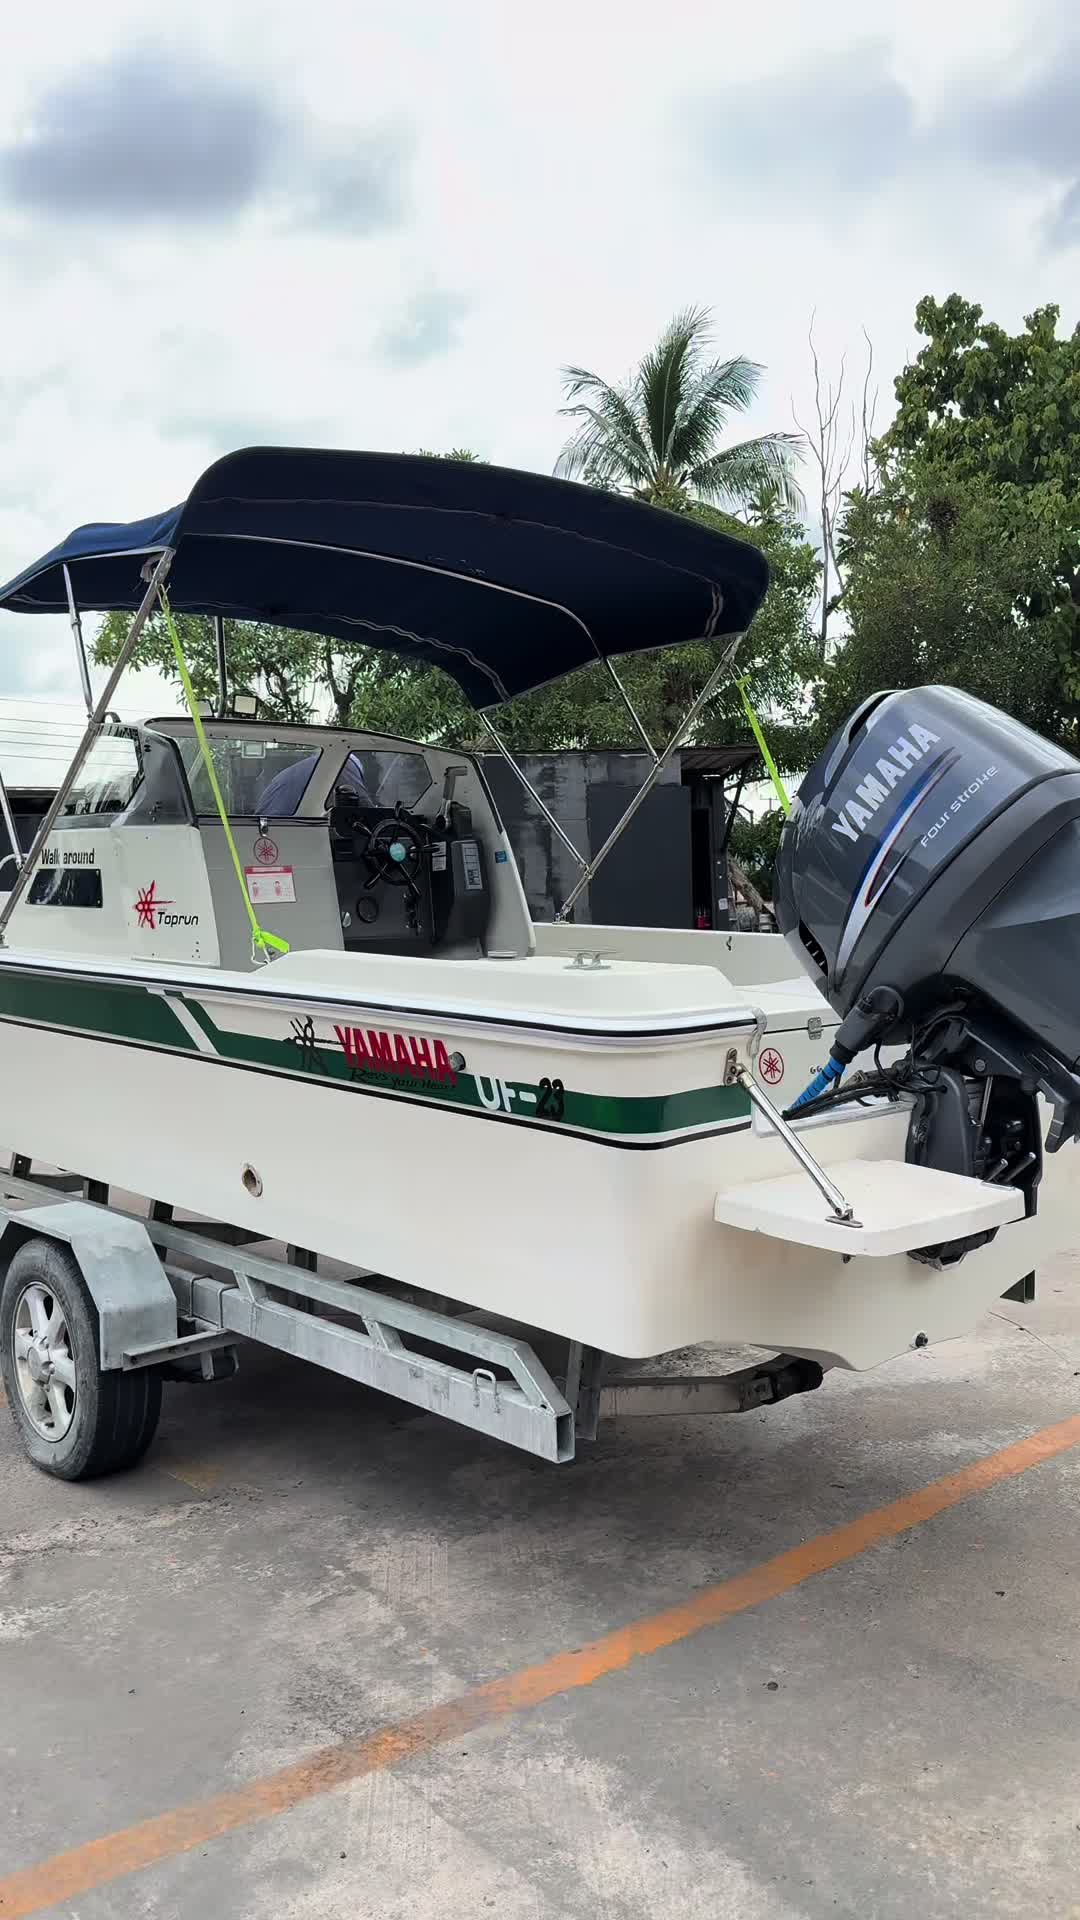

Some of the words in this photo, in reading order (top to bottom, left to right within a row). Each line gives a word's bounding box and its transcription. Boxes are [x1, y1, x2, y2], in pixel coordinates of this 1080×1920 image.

[832, 723, 941, 842] YAMAHA
[41, 848, 61, 865] Walk
[63, 848, 95, 865] around
[157, 911, 199, 928] Toprun
[333, 1025, 458, 1087] YAMAHA
